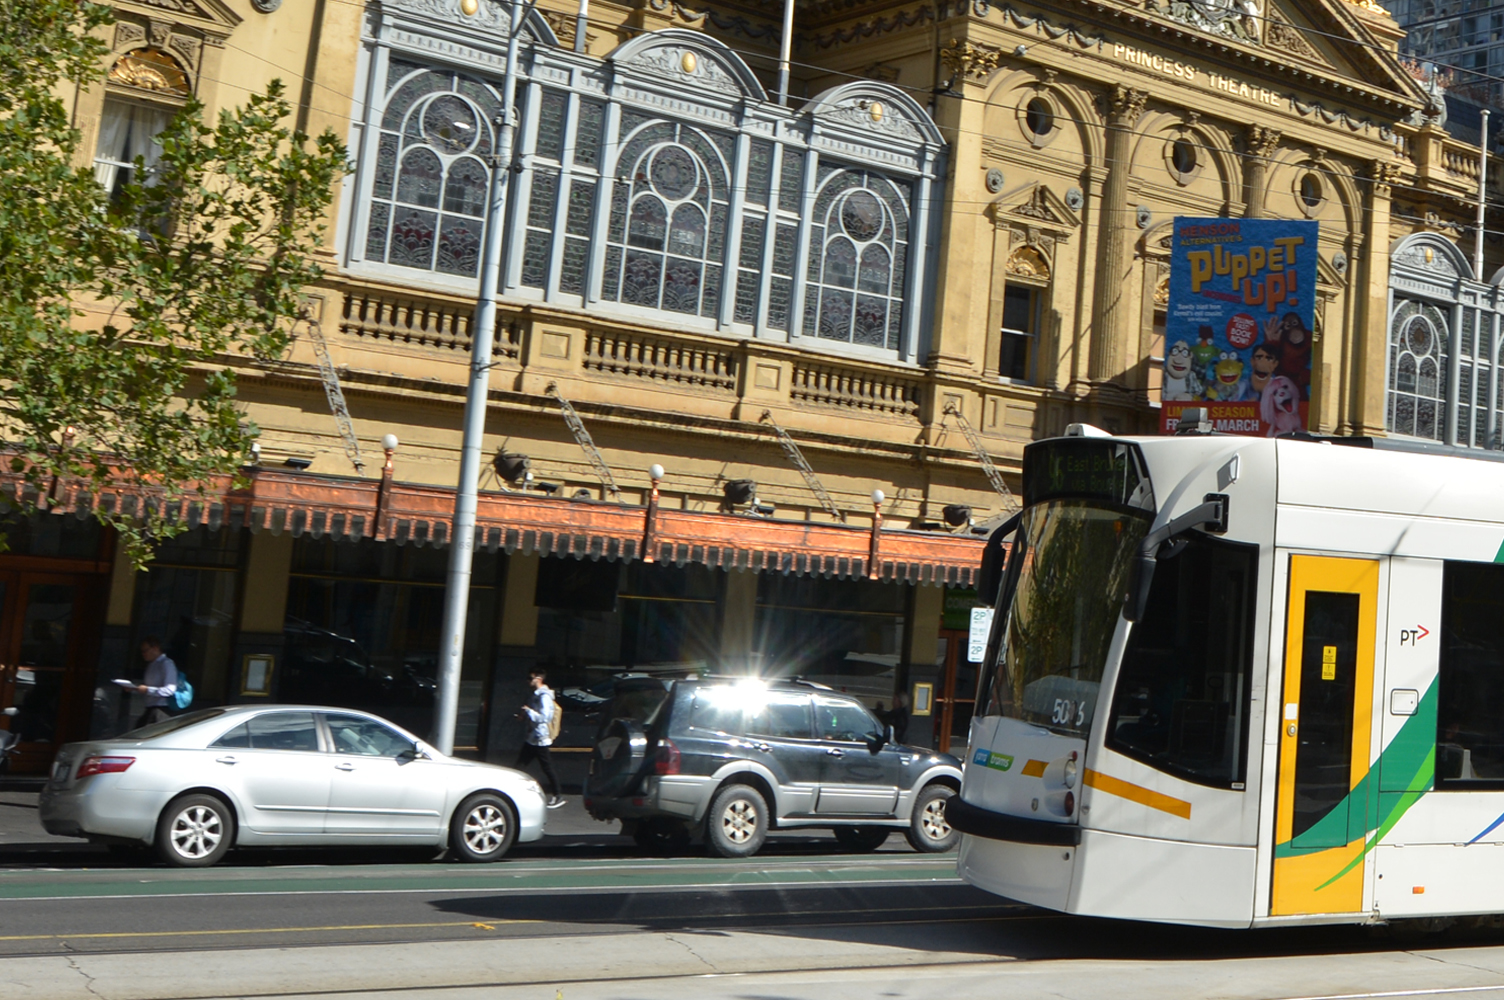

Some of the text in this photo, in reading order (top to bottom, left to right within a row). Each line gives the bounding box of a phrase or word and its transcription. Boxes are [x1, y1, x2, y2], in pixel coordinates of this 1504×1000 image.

[1208, 71, 1281, 107] THEATRE
[1180, 222, 1240, 237] HENSON
[1187, 236, 1304, 293] PUPPET
[1243, 269, 1298, 313] UP!
[1230, 327, 1252, 339] BOOK
[1212, 406, 1255, 418] SEASON
[1217, 419, 1259, 432] MARCH
[1067, 455, 1089, 472] East
[973, 611, 986, 621] 2P
[971, 645, 983, 655] 2P
